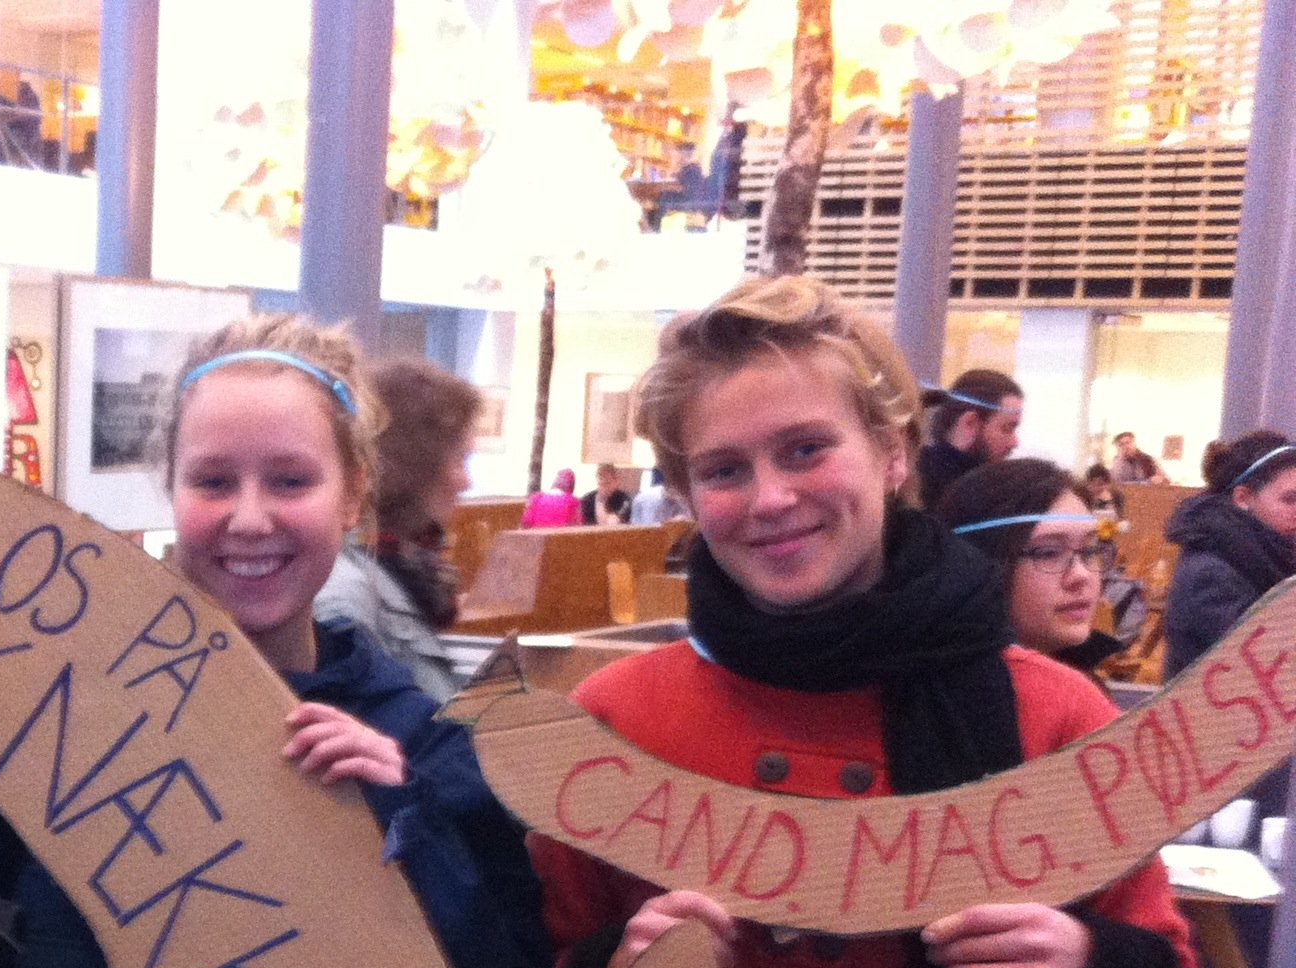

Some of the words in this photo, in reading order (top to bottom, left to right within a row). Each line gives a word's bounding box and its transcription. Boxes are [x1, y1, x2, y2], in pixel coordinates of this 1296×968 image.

[106, 594, 229, 733] PÅ
[555, 754, 807, 913] CAND.
[838, 788, 1085, 915] MAG.
[1076, 625, 1296, 848] PØLSE
